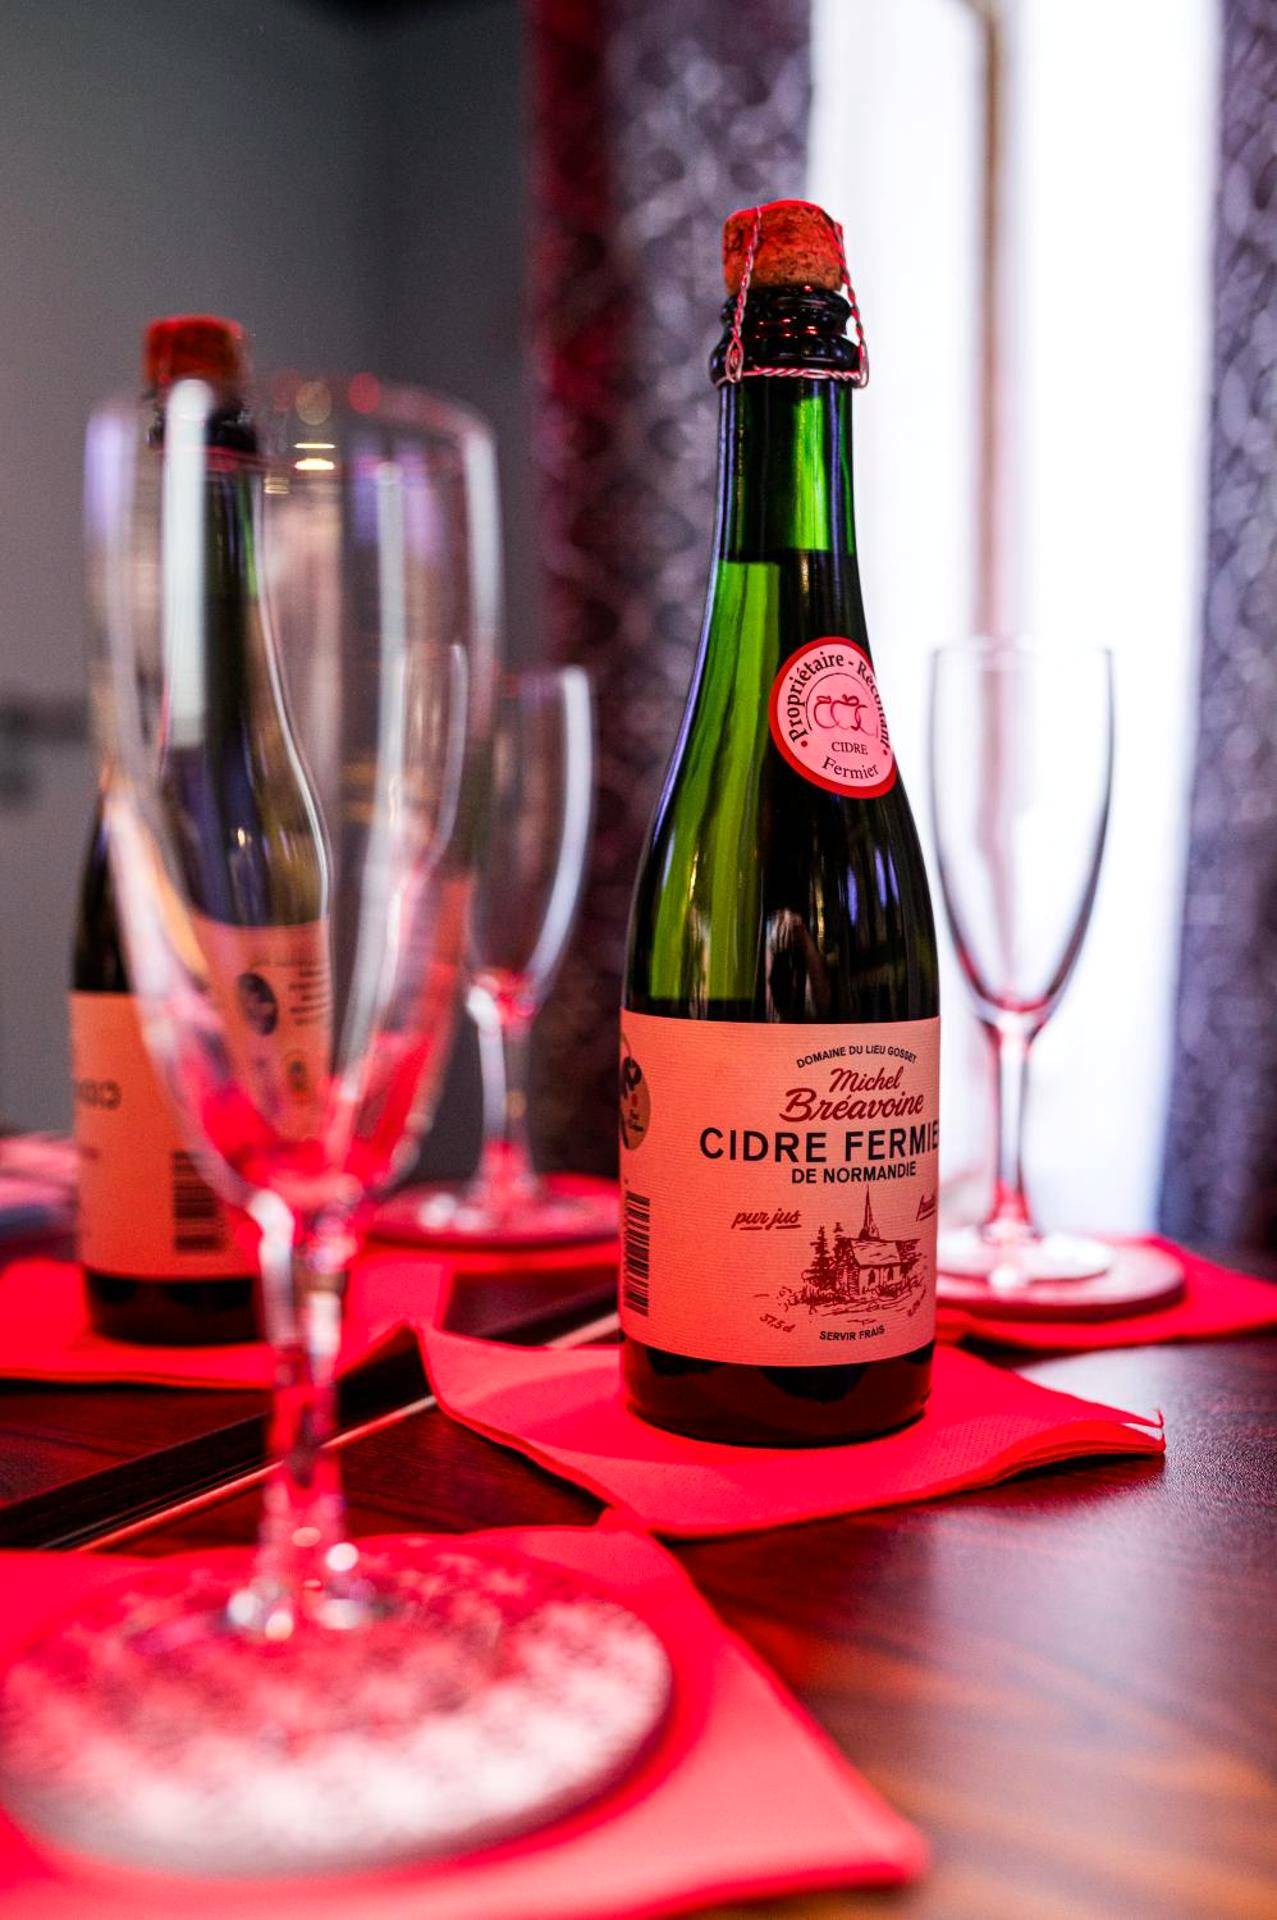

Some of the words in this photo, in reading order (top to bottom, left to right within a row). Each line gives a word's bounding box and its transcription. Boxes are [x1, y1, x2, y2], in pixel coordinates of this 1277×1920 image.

[787, 651, 844, 742] Propriétaire
[831, 741, 869, 755] CIDRE
[822, 756, 880, 779] Fermier
[796, 1046, 846, 1068] DOMAINE
[848, 1045, 862, 1055] DU
[865, 1045, 885, 1054] LIEU
[887, 1046, 917, 1064] GOSSET
[829, 1066, 904, 1093] Michel
[779, 1087, 924, 1122] Bréavoine
[700, 1127, 827, 1163] CIDRE
[845, 1119, 939, 1162] FERMIE
[791, 1168, 817, 1184] DE
[823, 1160, 917, 1184] NORMANDIE
[731, 1212, 769, 1230] pur
[765, 1208, 802, 1230] jus
[819, 1330, 856, 1341] SERVIR
[859, 1325, 885, 1340] FRAIS
